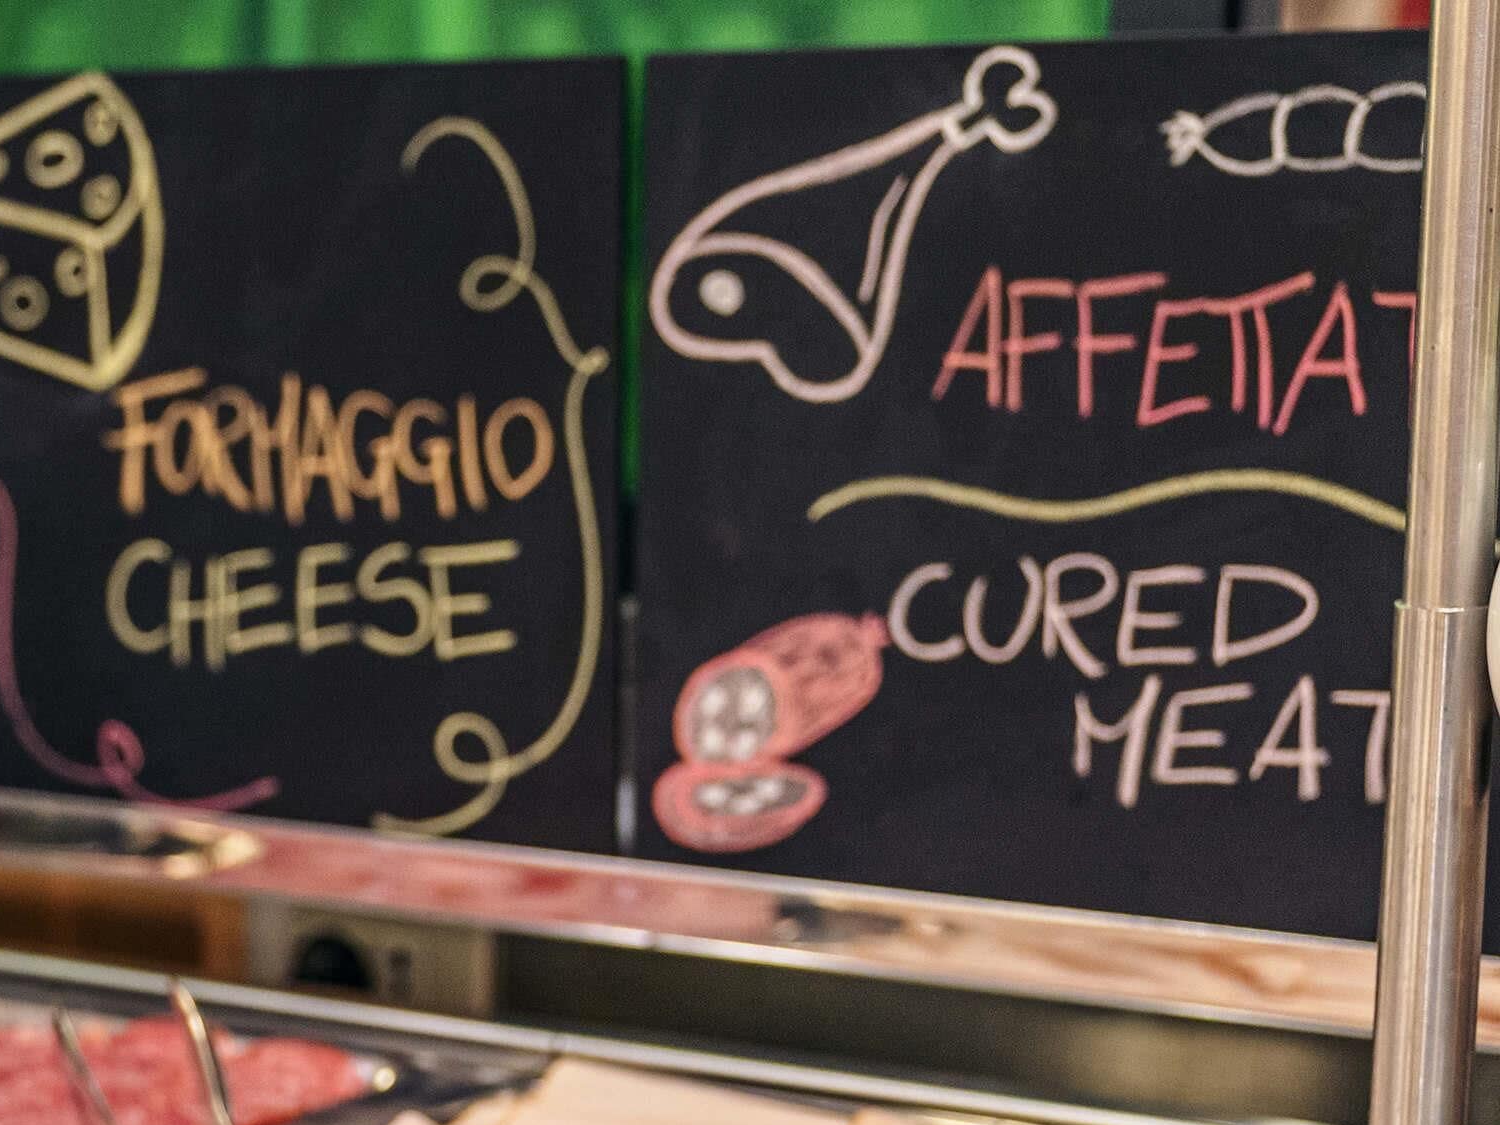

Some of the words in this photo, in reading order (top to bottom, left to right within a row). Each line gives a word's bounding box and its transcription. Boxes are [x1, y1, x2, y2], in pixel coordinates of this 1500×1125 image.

[103, 368, 556, 528] FORMAGGIO
[106, 536, 520, 672] CHEESE
[888, 553, 1320, 680] CURED
[1074, 675, 1392, 808] MEAT
